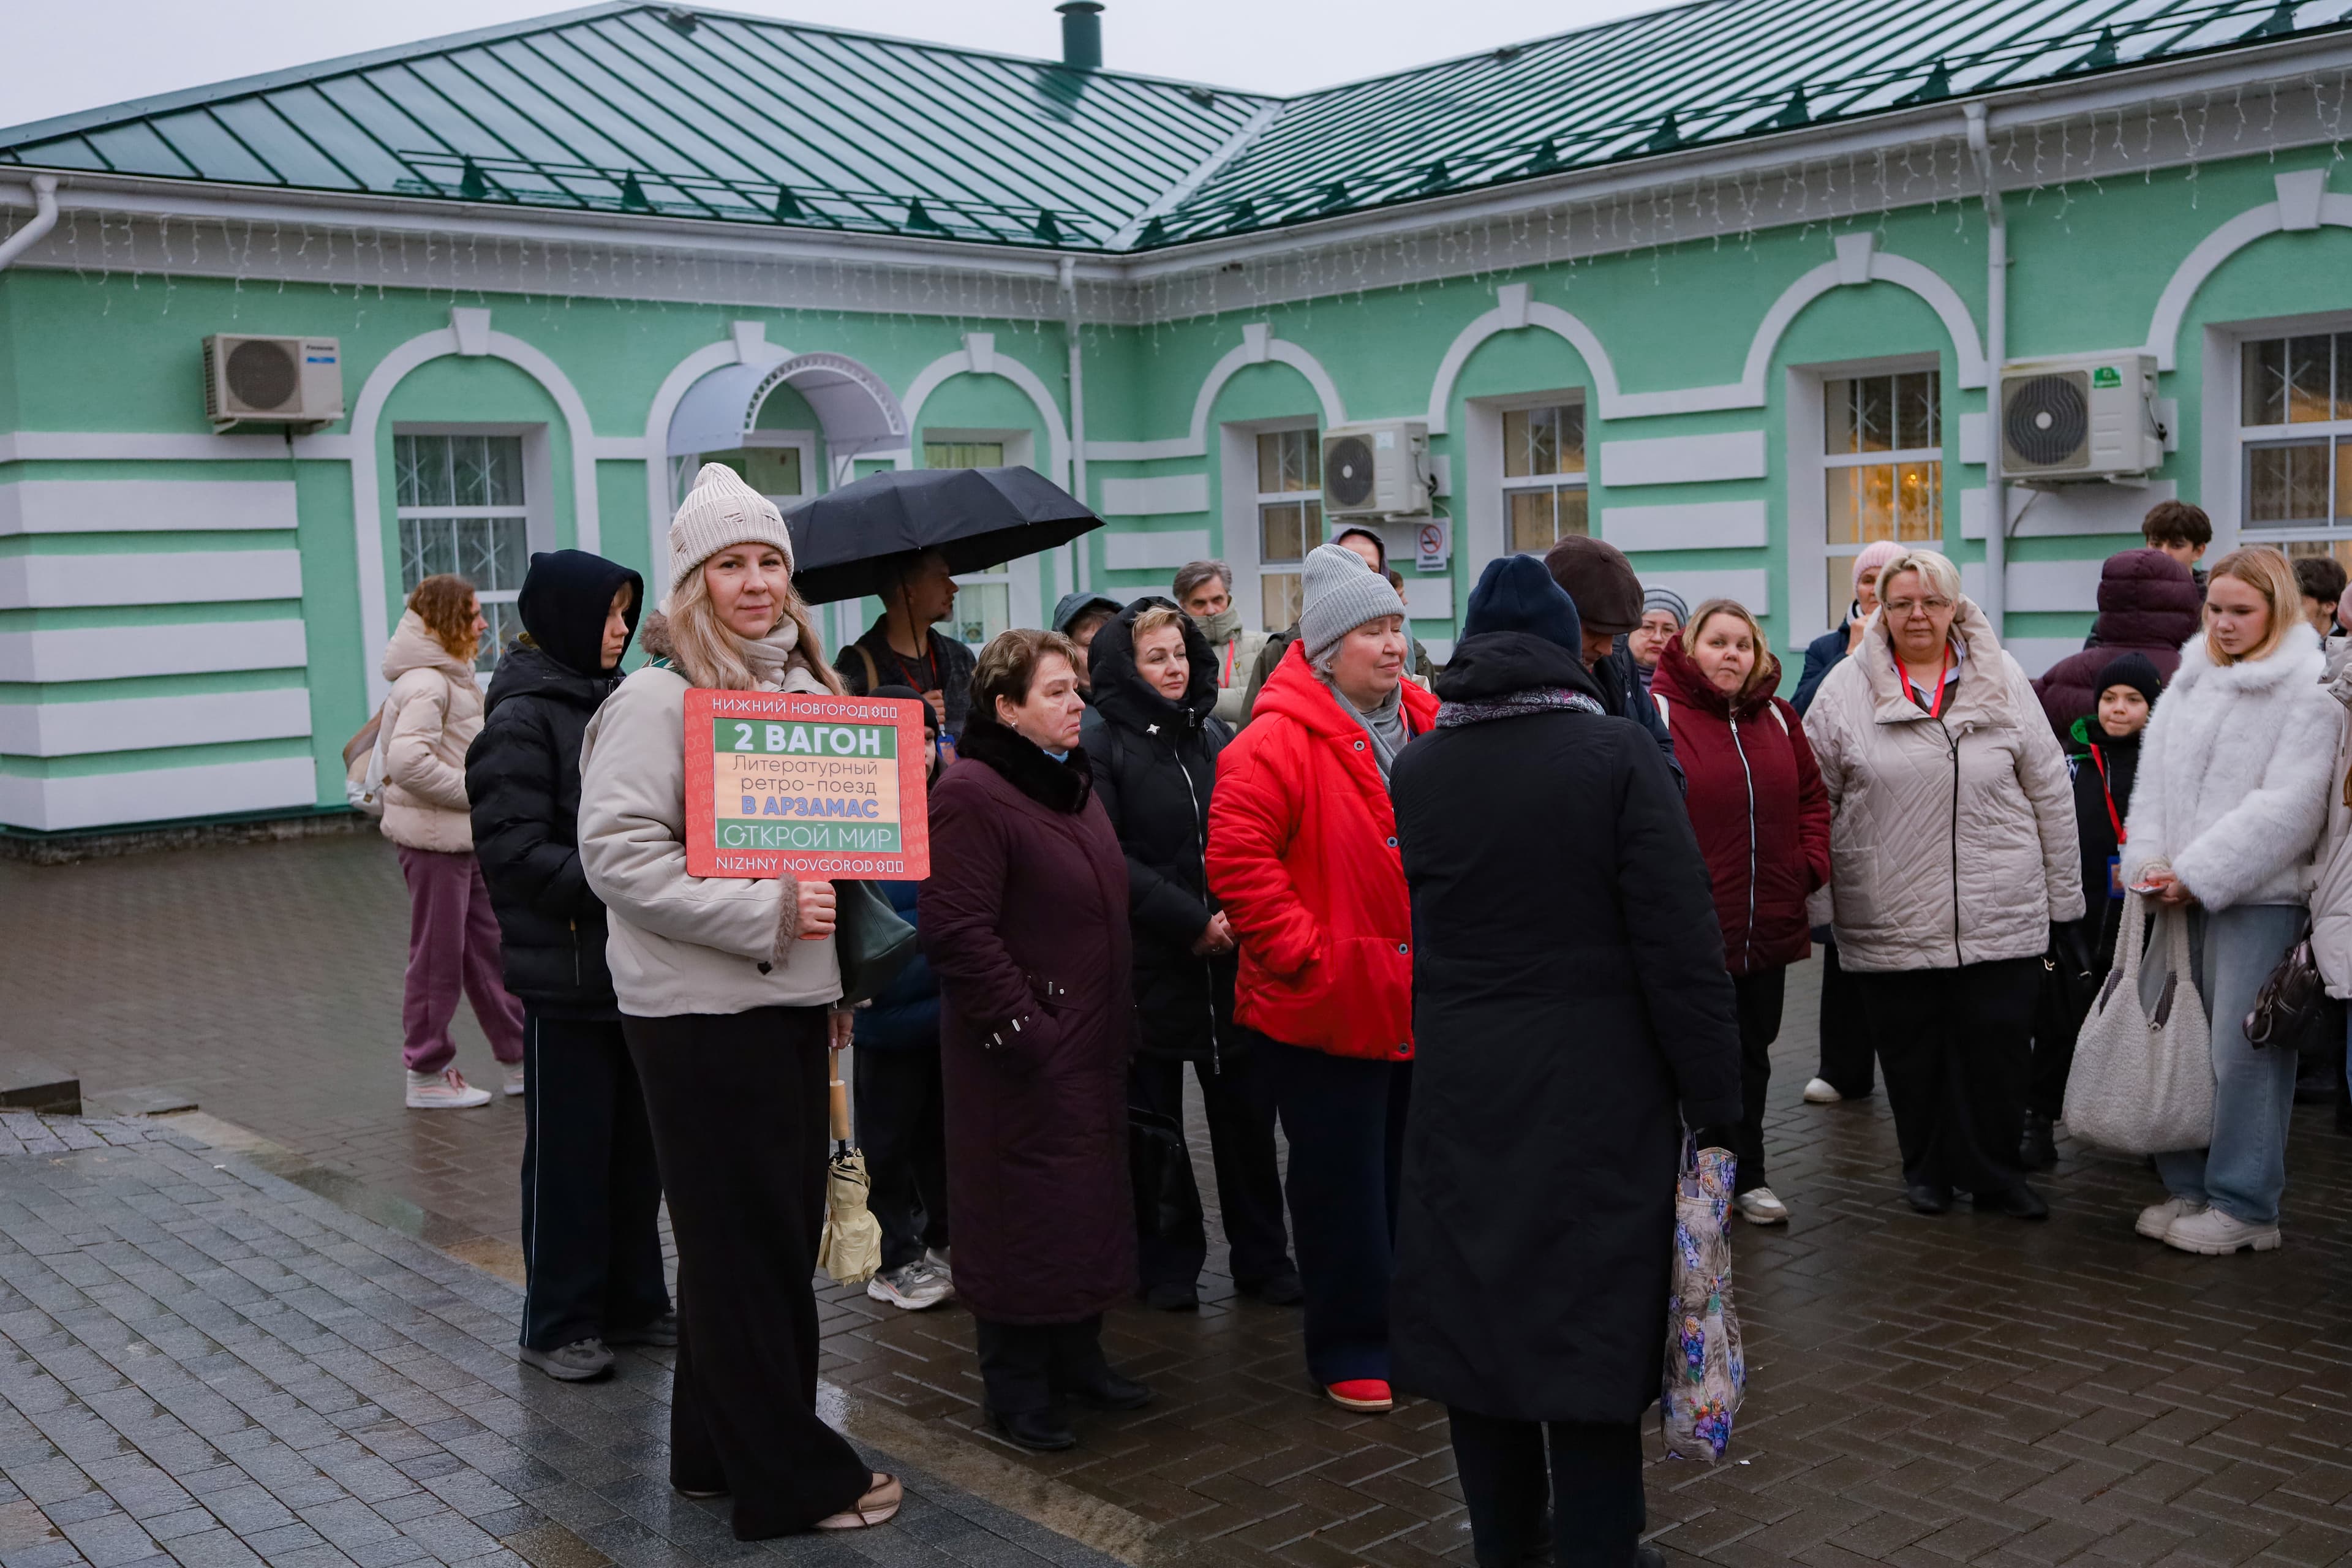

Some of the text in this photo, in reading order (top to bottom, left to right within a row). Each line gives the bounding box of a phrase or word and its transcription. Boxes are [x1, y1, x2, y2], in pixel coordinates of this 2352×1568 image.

[712, 698, 786, 714] НИЖНИЙ
[791, 703, 869, 719] НОВГОРОД
[734, 723, 880, 755] 2 ВАГОН
[733, 755, 878, 777] Литературный
[741, 777, 876, 796] ретро-поезд
[742, 796, 880, 818] В АРЗАМАС
[724, 824, 892, 848] ОТКРОЙ МИР
[716, 857, 778, 870] NIZHNY
[783, 858, 873, 873] NOVGOROD
